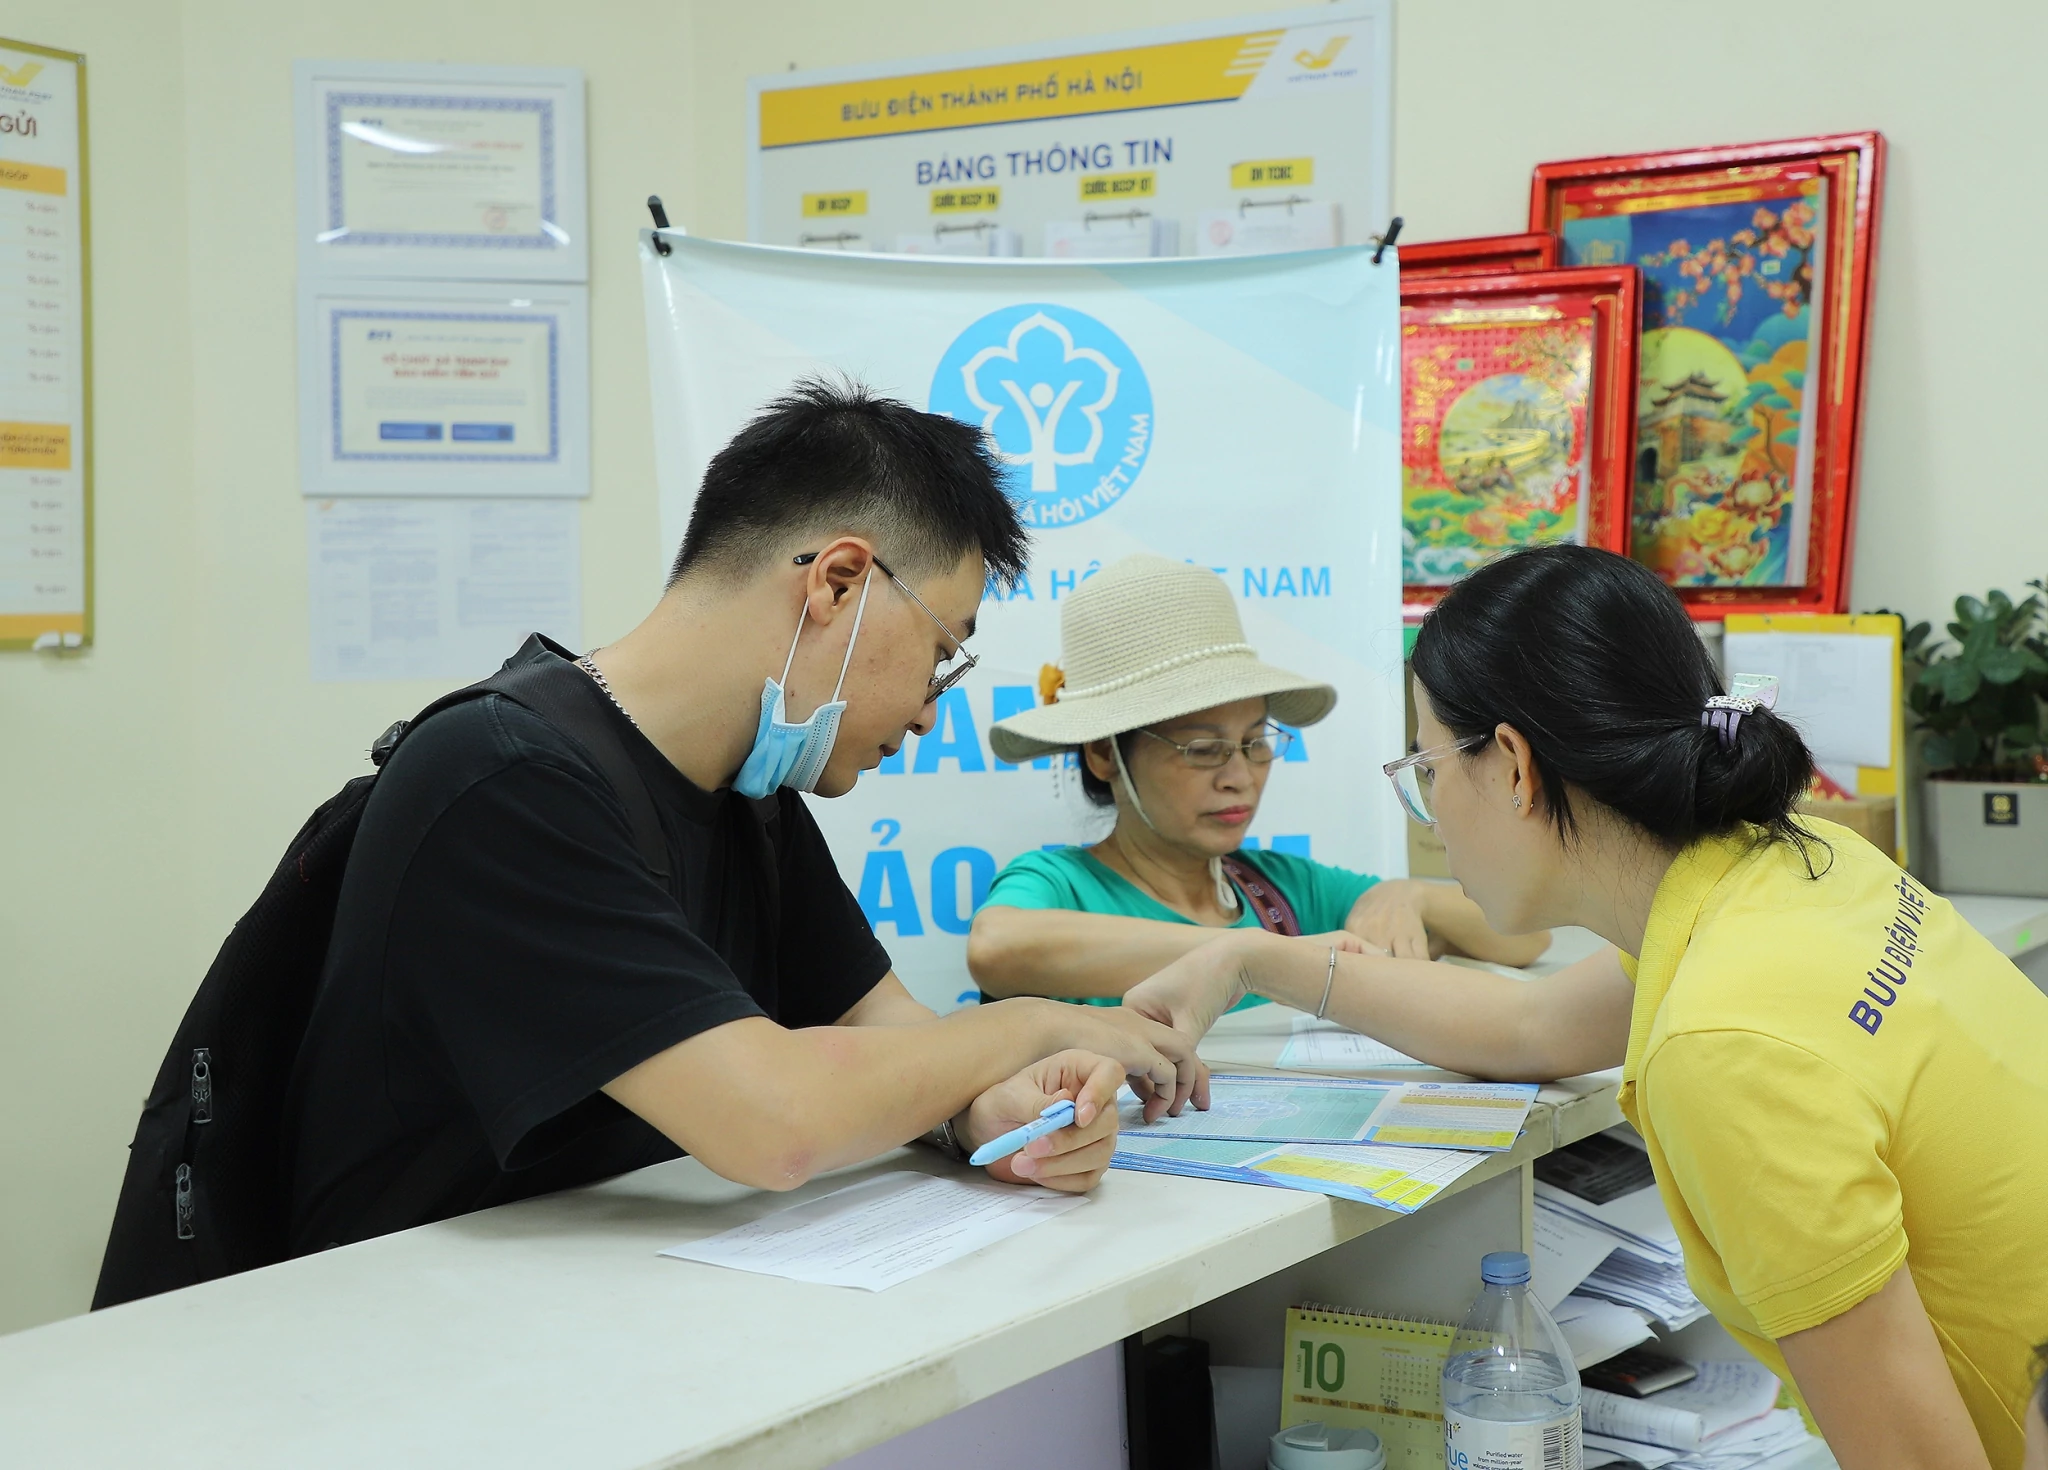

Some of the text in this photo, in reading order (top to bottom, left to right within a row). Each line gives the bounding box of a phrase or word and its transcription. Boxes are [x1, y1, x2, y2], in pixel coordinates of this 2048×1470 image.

[887, 89, 933, 117] ĐIỆN
[941, 82, 1008, 110] THÀNH
[1016, 71, 1060, 102] PHỐ
[1067, 69, 1097, 97] HÀ
[1104, 65, 1143, 93] NỘI
[1007, 142, 1113, 176] THÔNG
[1123, 137, 1173, 167] TIN
[1120, 413, 1150, 468] NAM
[1243, 566, 1331, 598] NAM
[857, 818, 996, 937] ẢO
[1894, 875, 1931, 926] VIỆT
[1884, 916, 1924, 968] ĐIỆN
[1848, 958, 1907, 1037] BƯU
[1299, 1340, 1346, 1393] 10
[1436, 1425, 1441, 1433] 3
[1486, 1450, 1507, 1458] Purified
[1490, 1458, 1523, 1466] million-year
